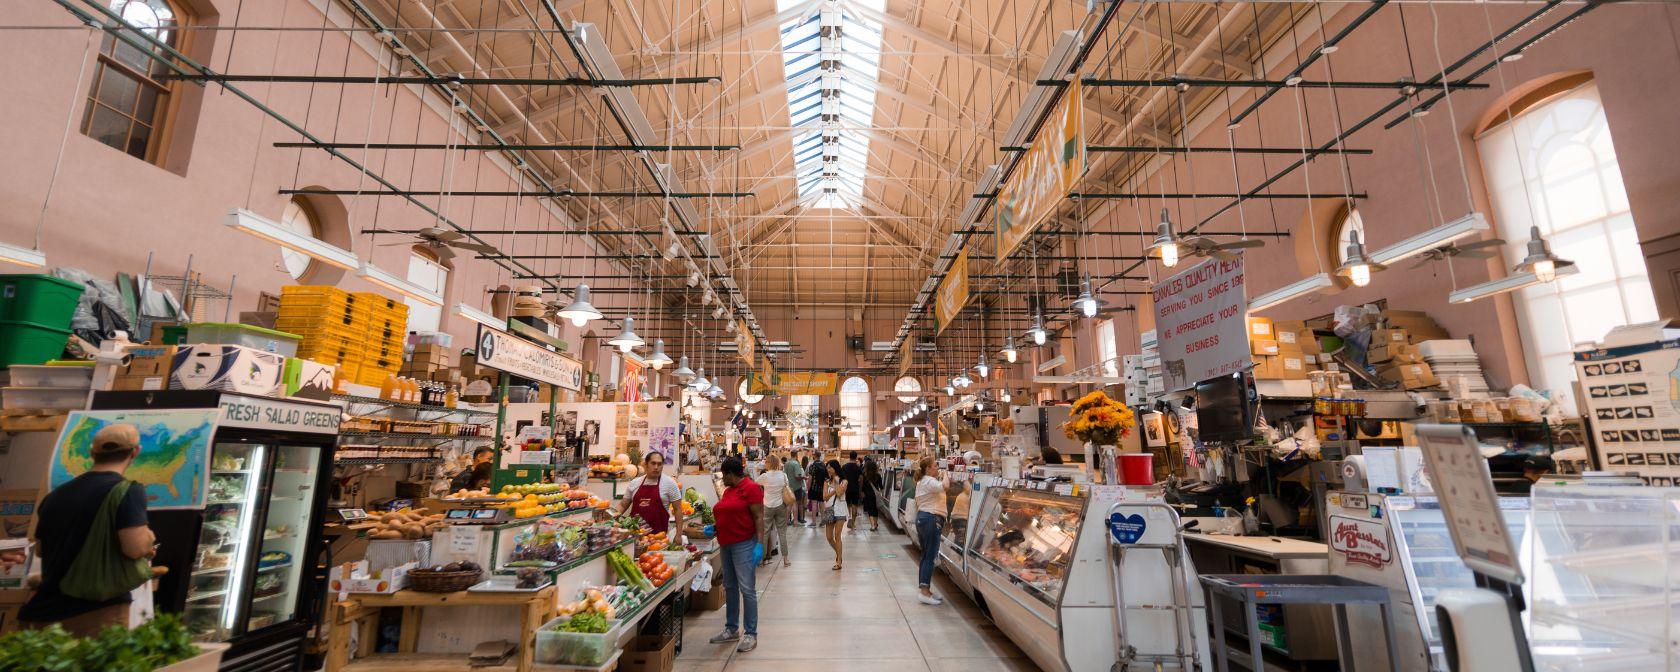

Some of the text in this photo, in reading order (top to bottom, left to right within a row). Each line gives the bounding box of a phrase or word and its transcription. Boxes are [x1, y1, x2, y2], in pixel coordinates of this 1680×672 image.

[1153, 279, 1183, 303] CANALES
[1185, 262, 1217, 289] QUALITY
[1160, 303, 1187, 318] SERVING
[1189, 293, 1203, 306] YOU
[1207, 281, 1229, 299] SINCE
[1176, 313, 1215, 336] APPRECIATE
[1218, 304, 1239, 319] YOUR
[482, 333, 492, 359] 4
[1185, 334, 1220, 354] BUSINESS
[265, 406, 300, 425] SALAD
[303, 411, 340, 429] GREENS
[1335, 521, 1358, 542] Aunt
